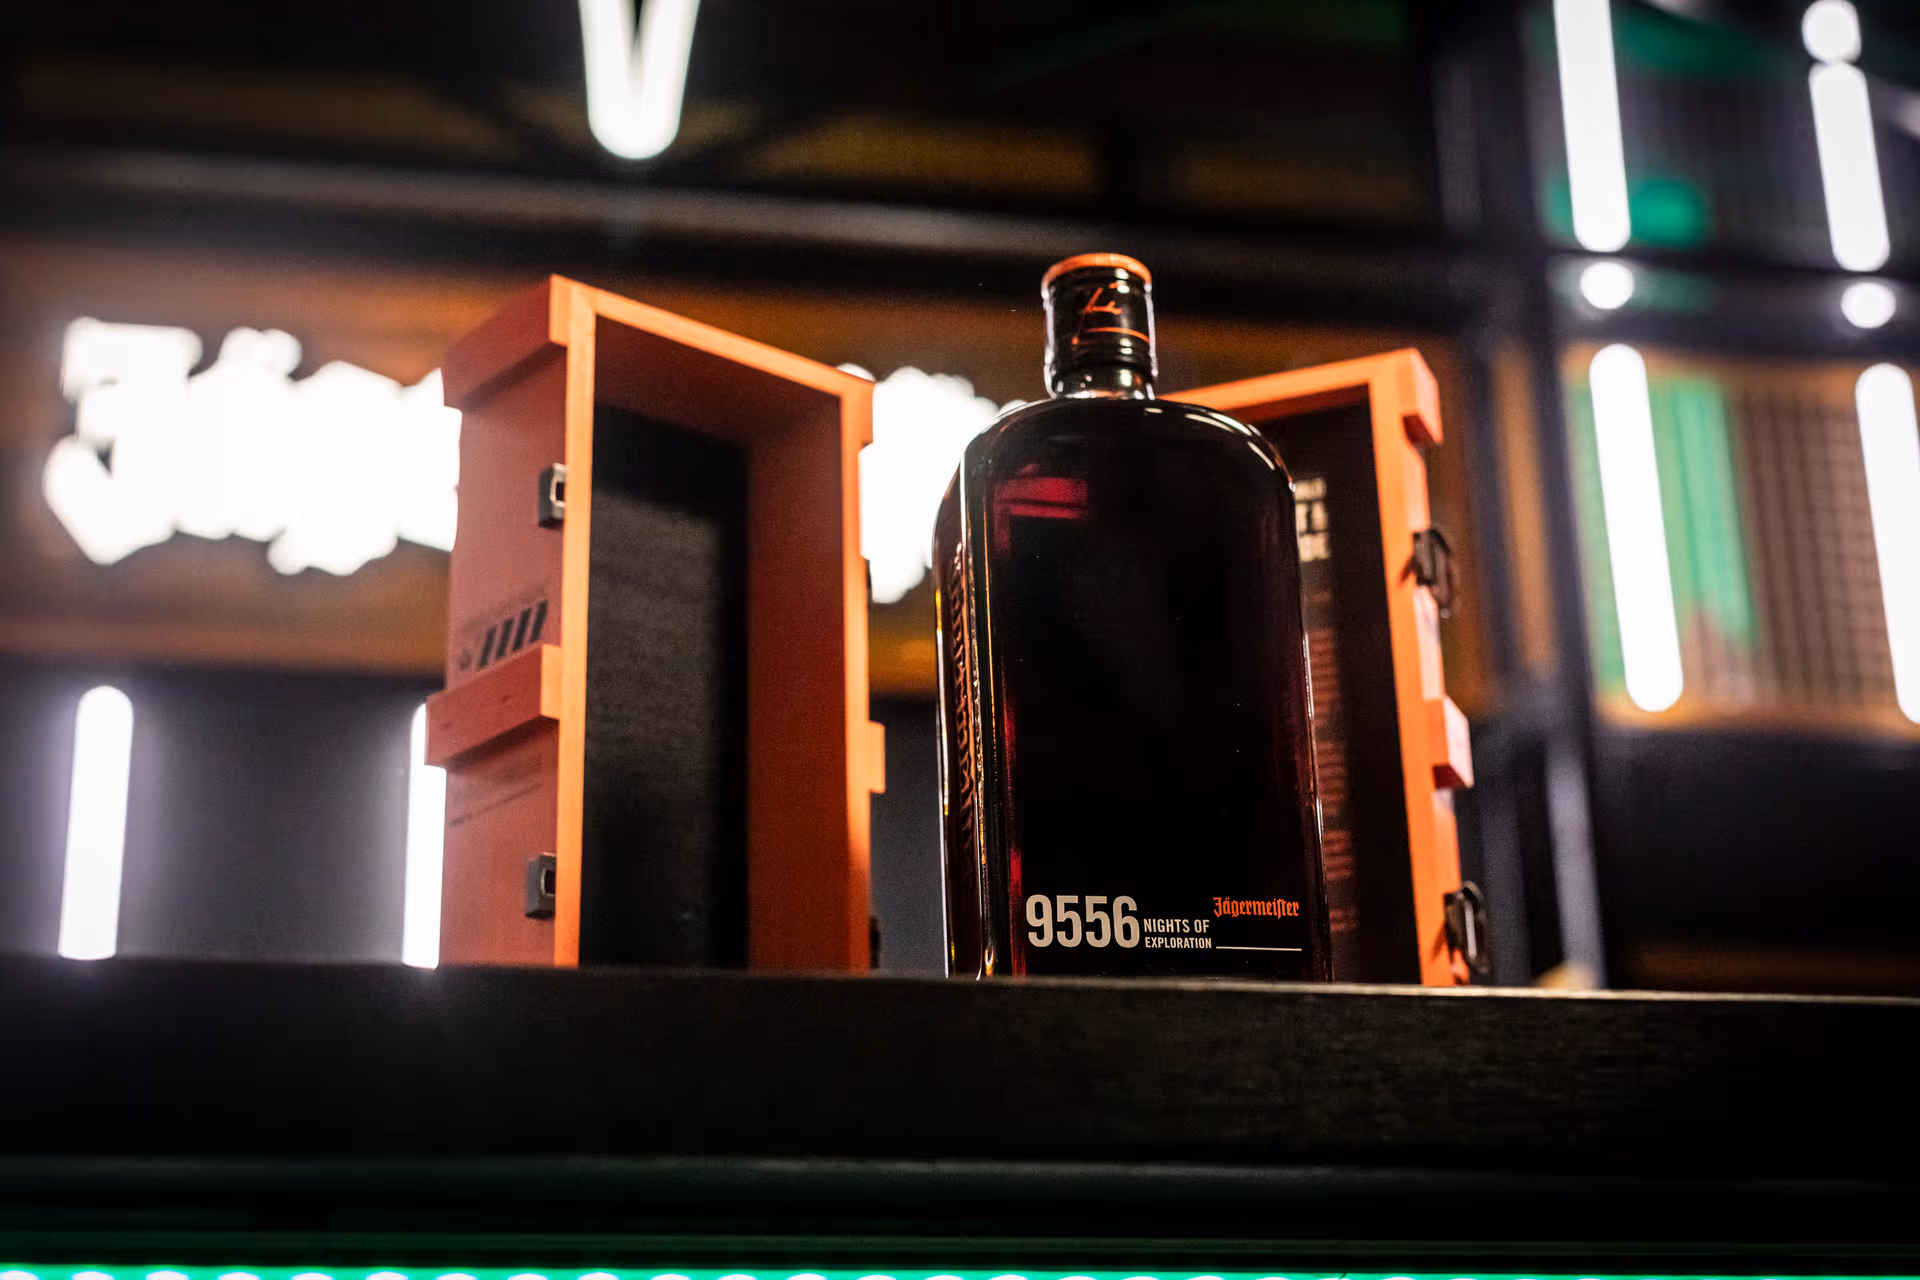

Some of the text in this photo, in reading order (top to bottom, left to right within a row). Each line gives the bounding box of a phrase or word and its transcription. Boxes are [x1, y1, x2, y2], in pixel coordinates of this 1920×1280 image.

[1026, 894, 1141, 948] 9556
[1143, 918, 1210, 934] NIGHTS OF
[1144, 936, 1212, 949] EXPLORATION
